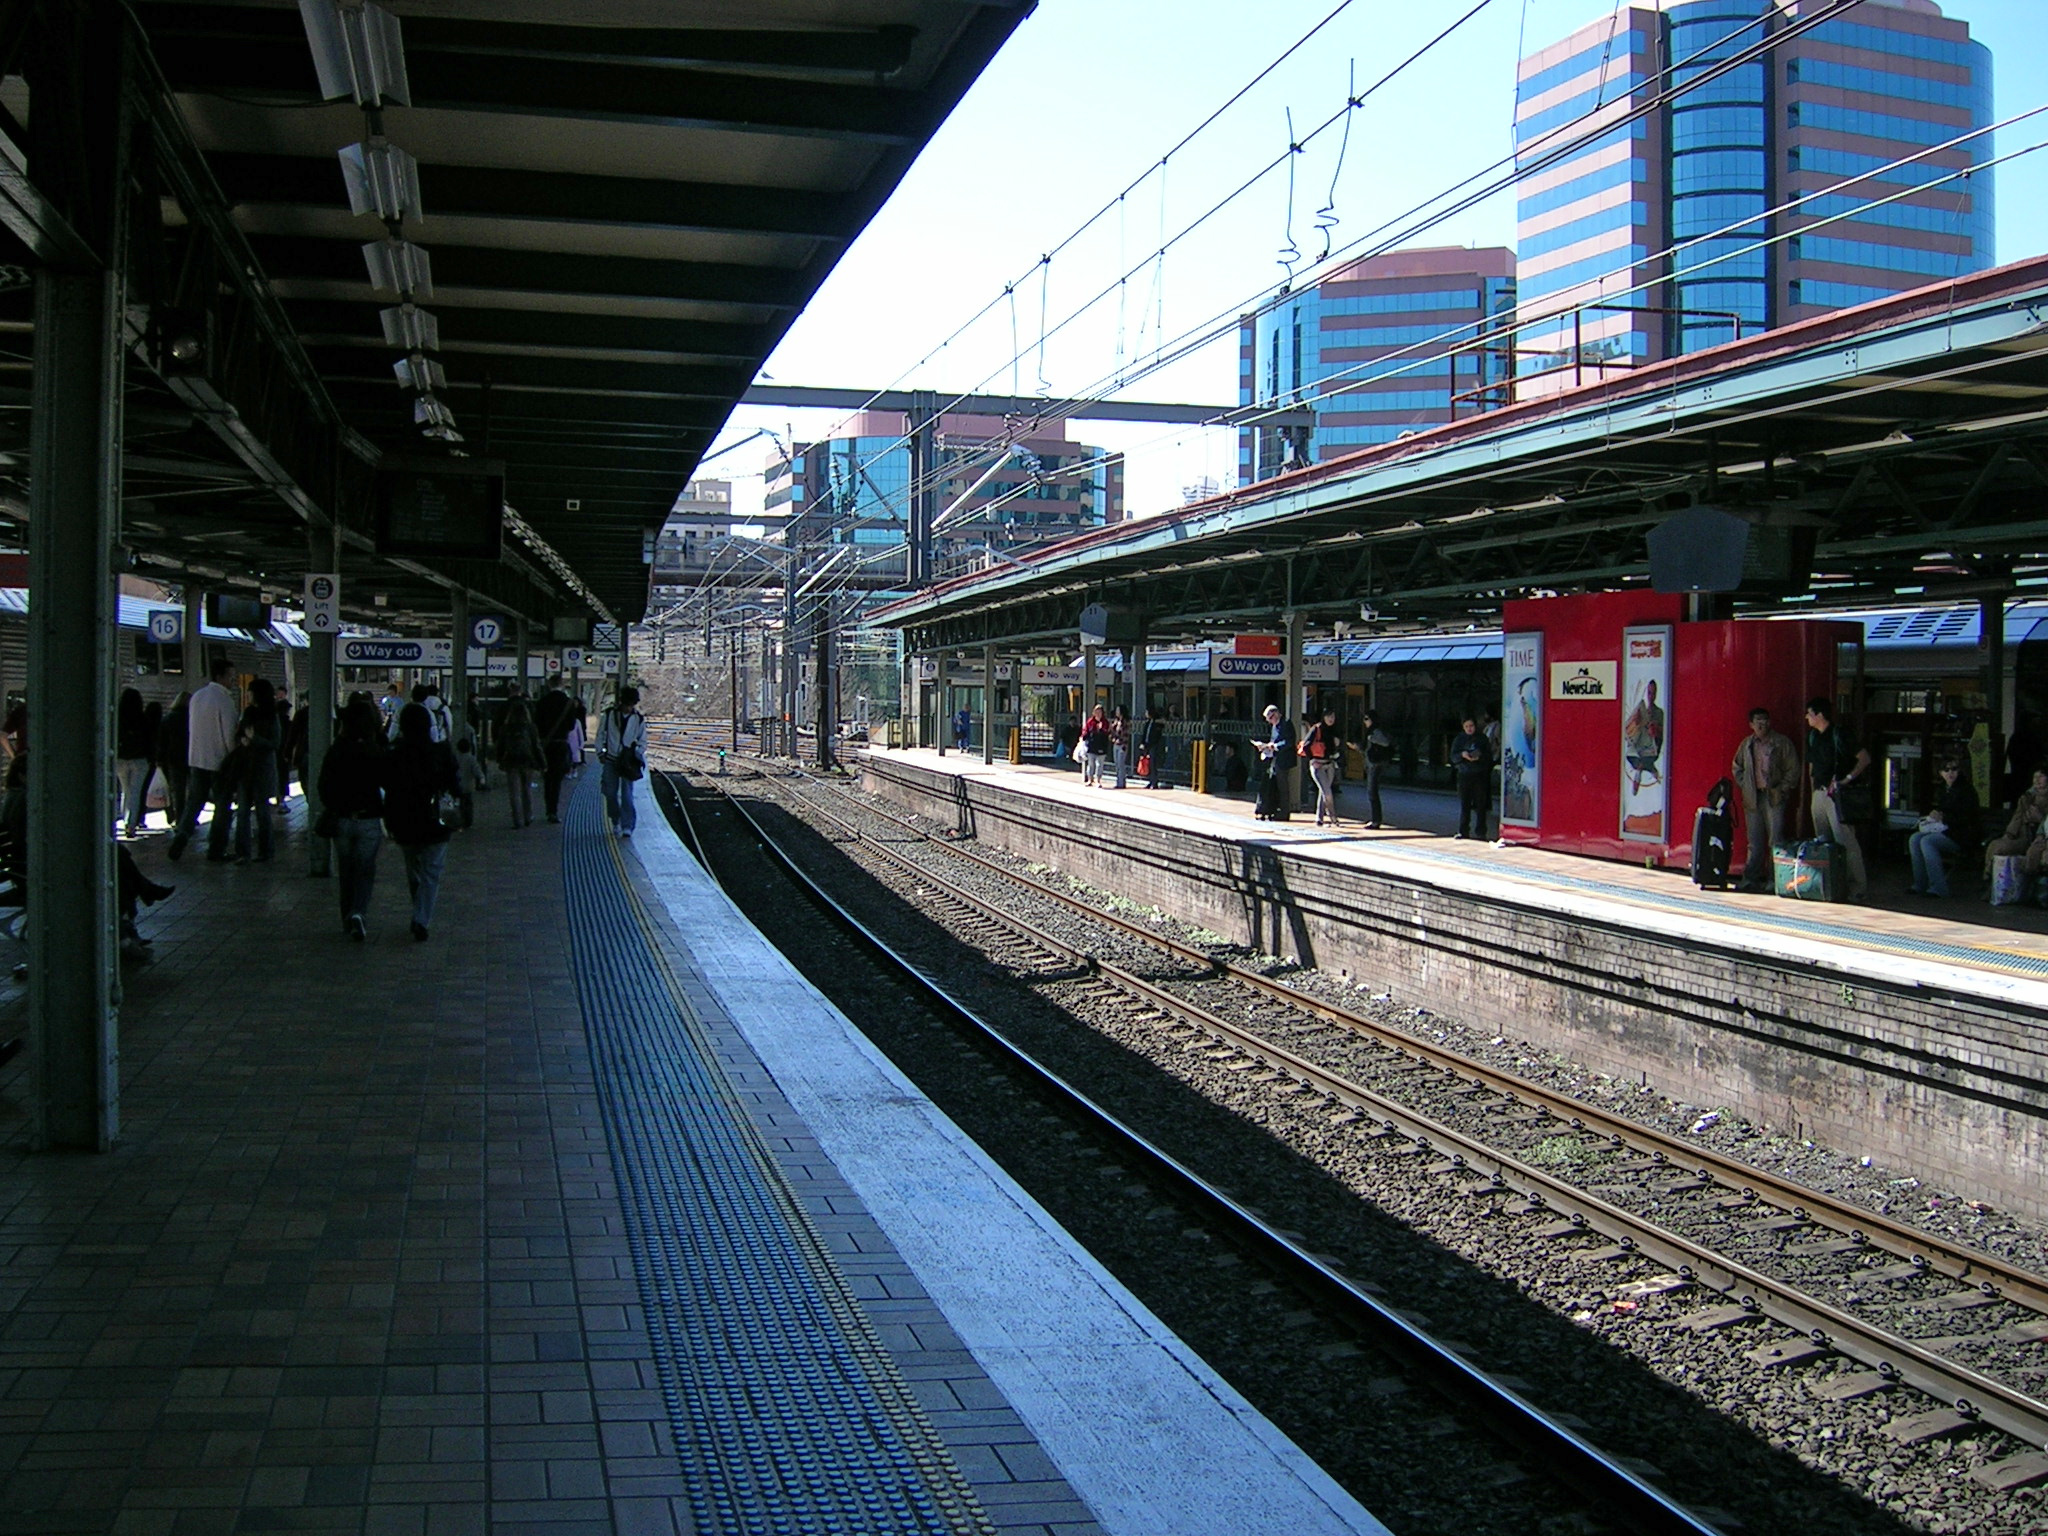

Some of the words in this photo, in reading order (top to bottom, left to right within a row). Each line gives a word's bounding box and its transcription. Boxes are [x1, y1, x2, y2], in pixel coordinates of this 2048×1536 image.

[155, 619, 173, 634] 16
[478, 624, 496, 639] 17
[363, 644, 393, 658] Way
[396, 645, 419, 657] out
[1310, 657, 1326, 666] Lift
[1508, 649, 1534, 668] TIME
[1234, 659, 1261, 673] Way
[1262, 659, 1282, 672] out
[1047, 671, 1059, 679] No
[1063, 672, 1080, 681] way
[1562, 680, 1604, 695] NewsLink
